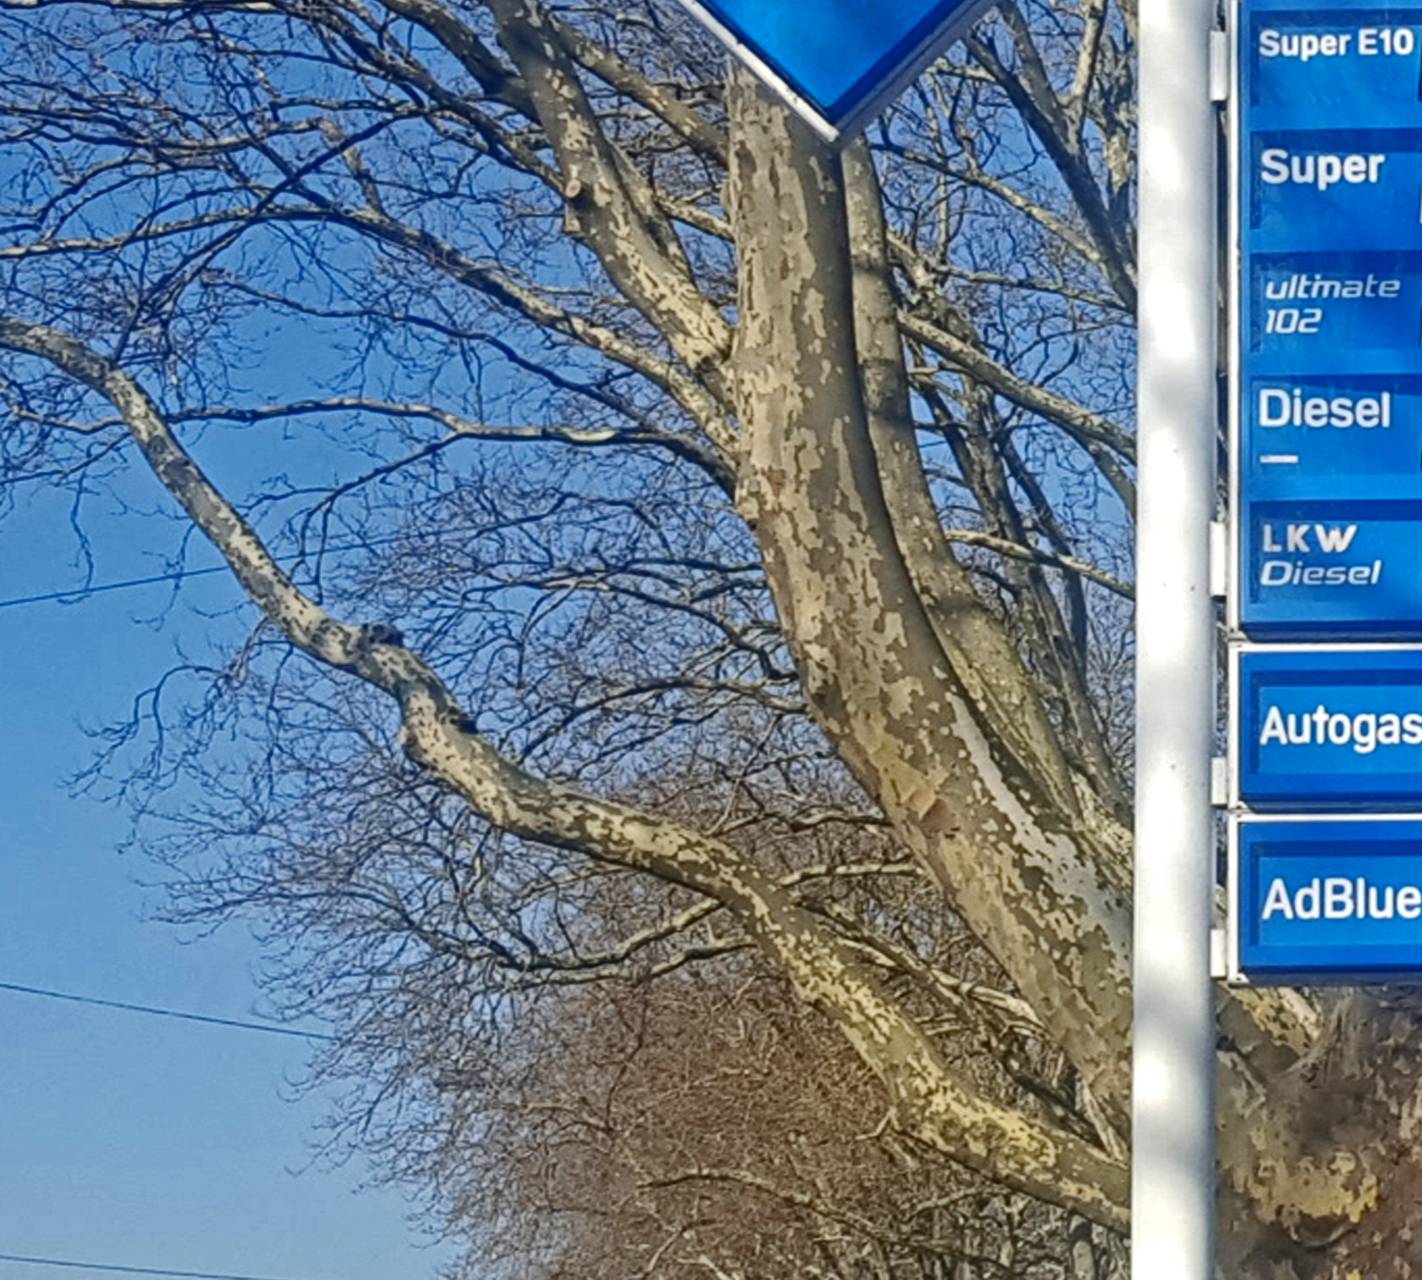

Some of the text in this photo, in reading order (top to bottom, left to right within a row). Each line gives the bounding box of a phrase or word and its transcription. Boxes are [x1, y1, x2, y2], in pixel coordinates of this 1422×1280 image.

[1258, 28, 1414, 62] Super E10
[1260, 149, 1385, 191] Super
[1266, 275, 1401, 300] ultimate
[1265, 309, 1322, 335] 102
[1259, 389, 1391, 428] Diesel
[1262, 524, 1358, 554] LKW
[1259, 560, 1382, 587] Diesel
[1261, 877, 1422, 920] AdBlue
